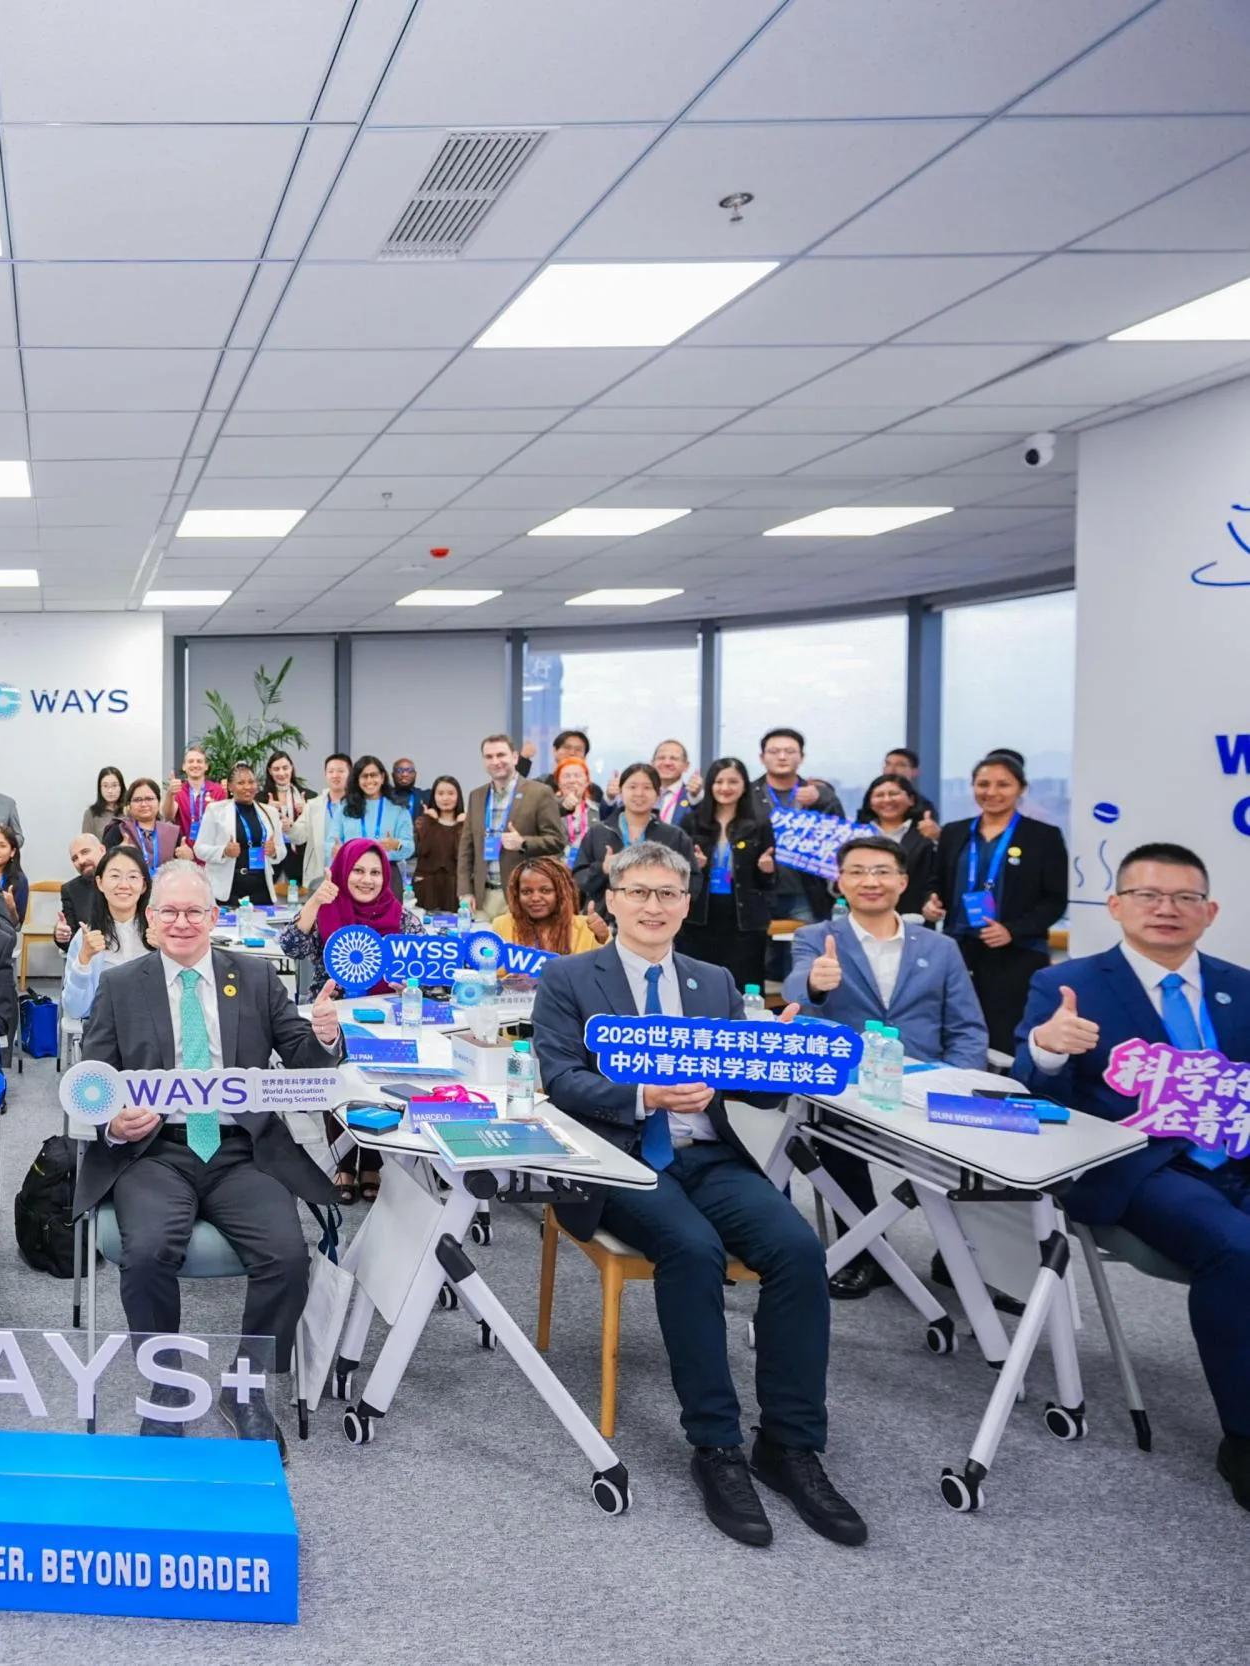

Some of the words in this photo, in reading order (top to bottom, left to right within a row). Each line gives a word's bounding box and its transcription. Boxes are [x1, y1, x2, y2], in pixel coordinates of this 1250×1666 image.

[30, 689, 129, 713] WAYS
[390, 940, 459, 960] WYSS
[391, 960, 458, 980] 2026
[597, 1025, 852, 1058] 2026世界青年科学家峰会
[610, 1051, 838, 1085] 中外青年科学家座谈会
[126, 1077, 247, 1106] WAYS
[261, 1078, 337, 1087] 世界青年科学家联合会
[262, 1087, 283, 1095] World
[284, 1087, 325, 1095] Association
[262, 1095, 271, 1103] of
[271, 1095, 294, 1104] Young
[294, 1095, 327, 1103] Scientists
[412, 1112, 451, 1121] MARCELO
[930, 1111, 952, 1120] SUN
[41, 1549, 151, 1587] BEYOND
[159, 1554, 271, 1592] BORDER
